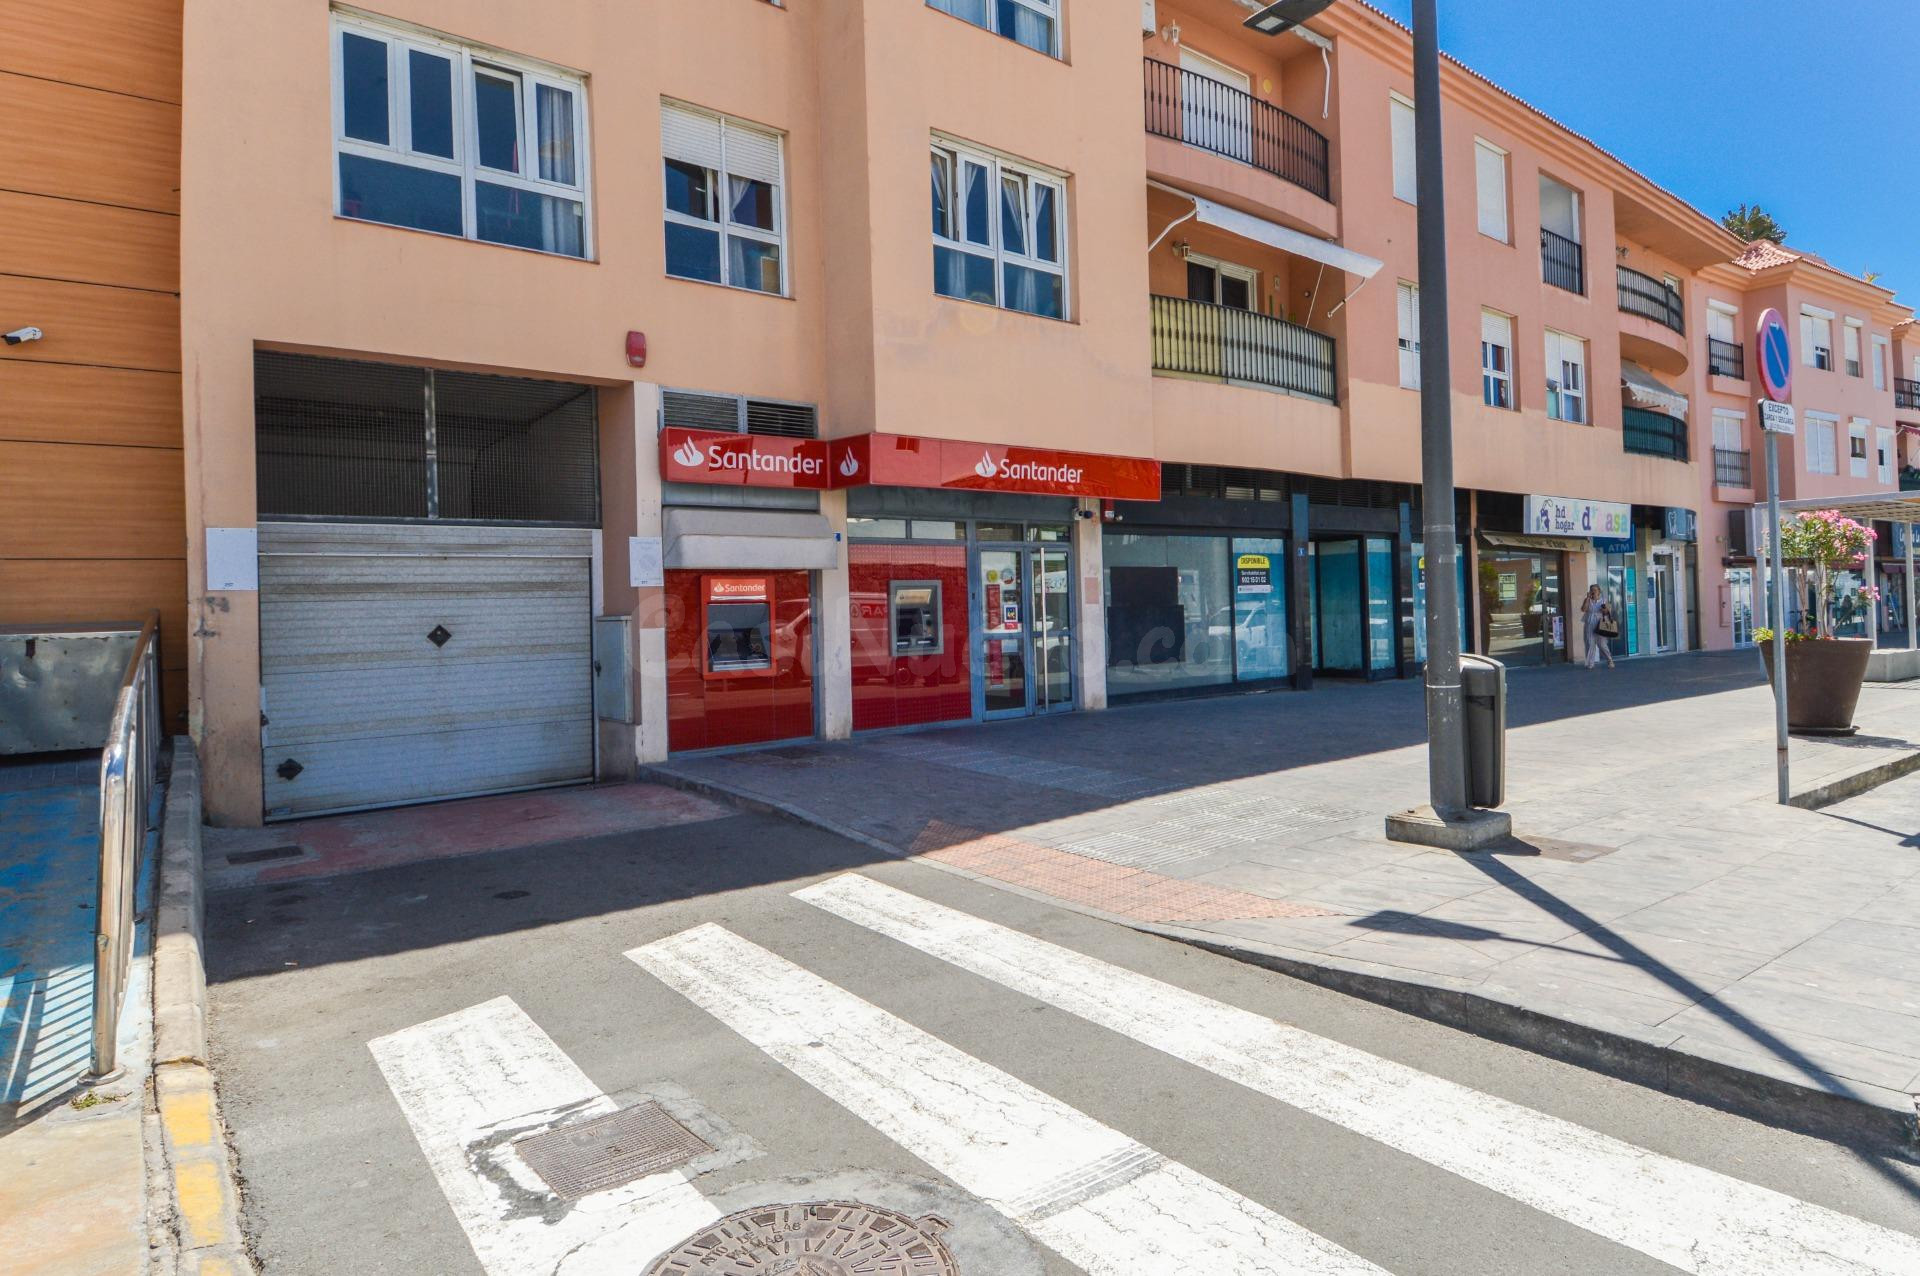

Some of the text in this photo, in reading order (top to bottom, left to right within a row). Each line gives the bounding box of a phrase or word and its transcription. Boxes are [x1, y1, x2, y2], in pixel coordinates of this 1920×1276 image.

[1768, 403, 1789, 415] EXCEPTO
[708, 445, 824, 474] Santander
[1000, 458, 1083, 483] Santander
[1555, 505, 1566, 518] hd
[1555, 519, 1575, 533] hogar
[1608, 544, 1630, 553] ATM
[1240, 557, 1266, 565] DISPONIBLE
[724, 583, 766, 593] Santander
